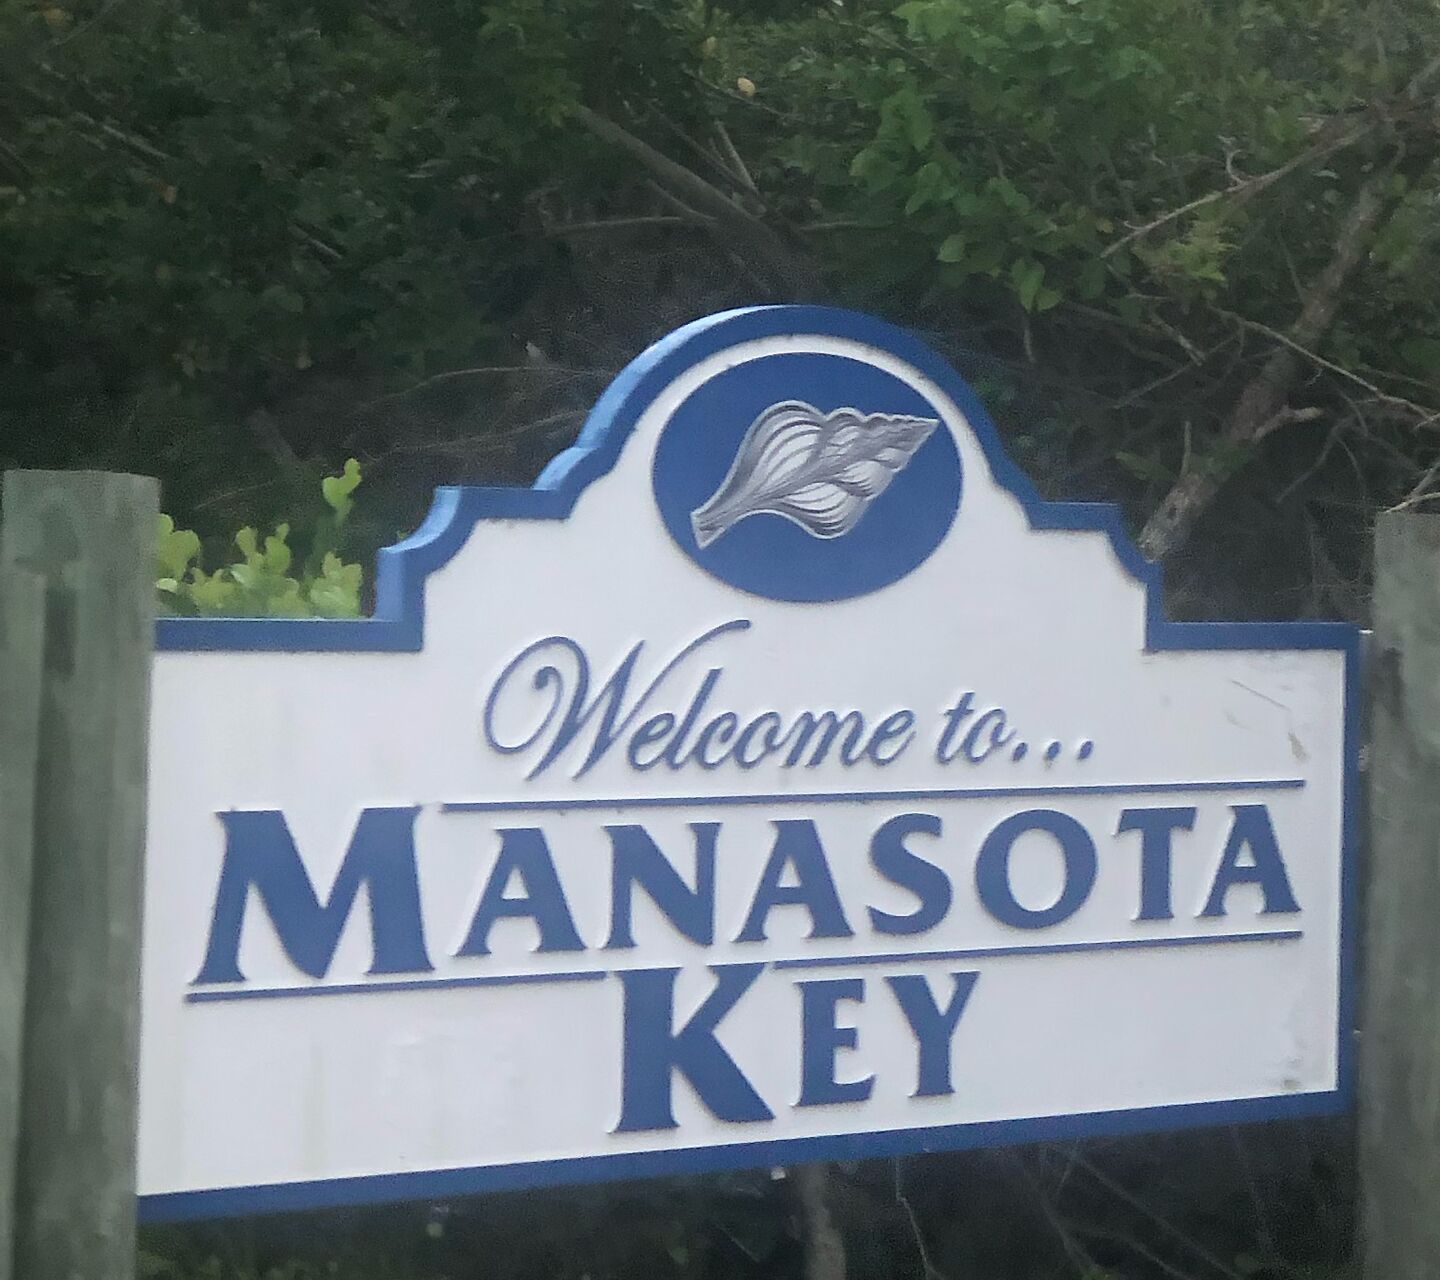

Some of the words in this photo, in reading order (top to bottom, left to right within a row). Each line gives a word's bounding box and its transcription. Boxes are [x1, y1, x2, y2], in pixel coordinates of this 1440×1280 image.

[483, 617, 917, 780] Welcome
[937, 690, 1096, 767] to...
[190, 803, 1303, 986] MANASOTA
[609, 961, 980, 1134] KEY
